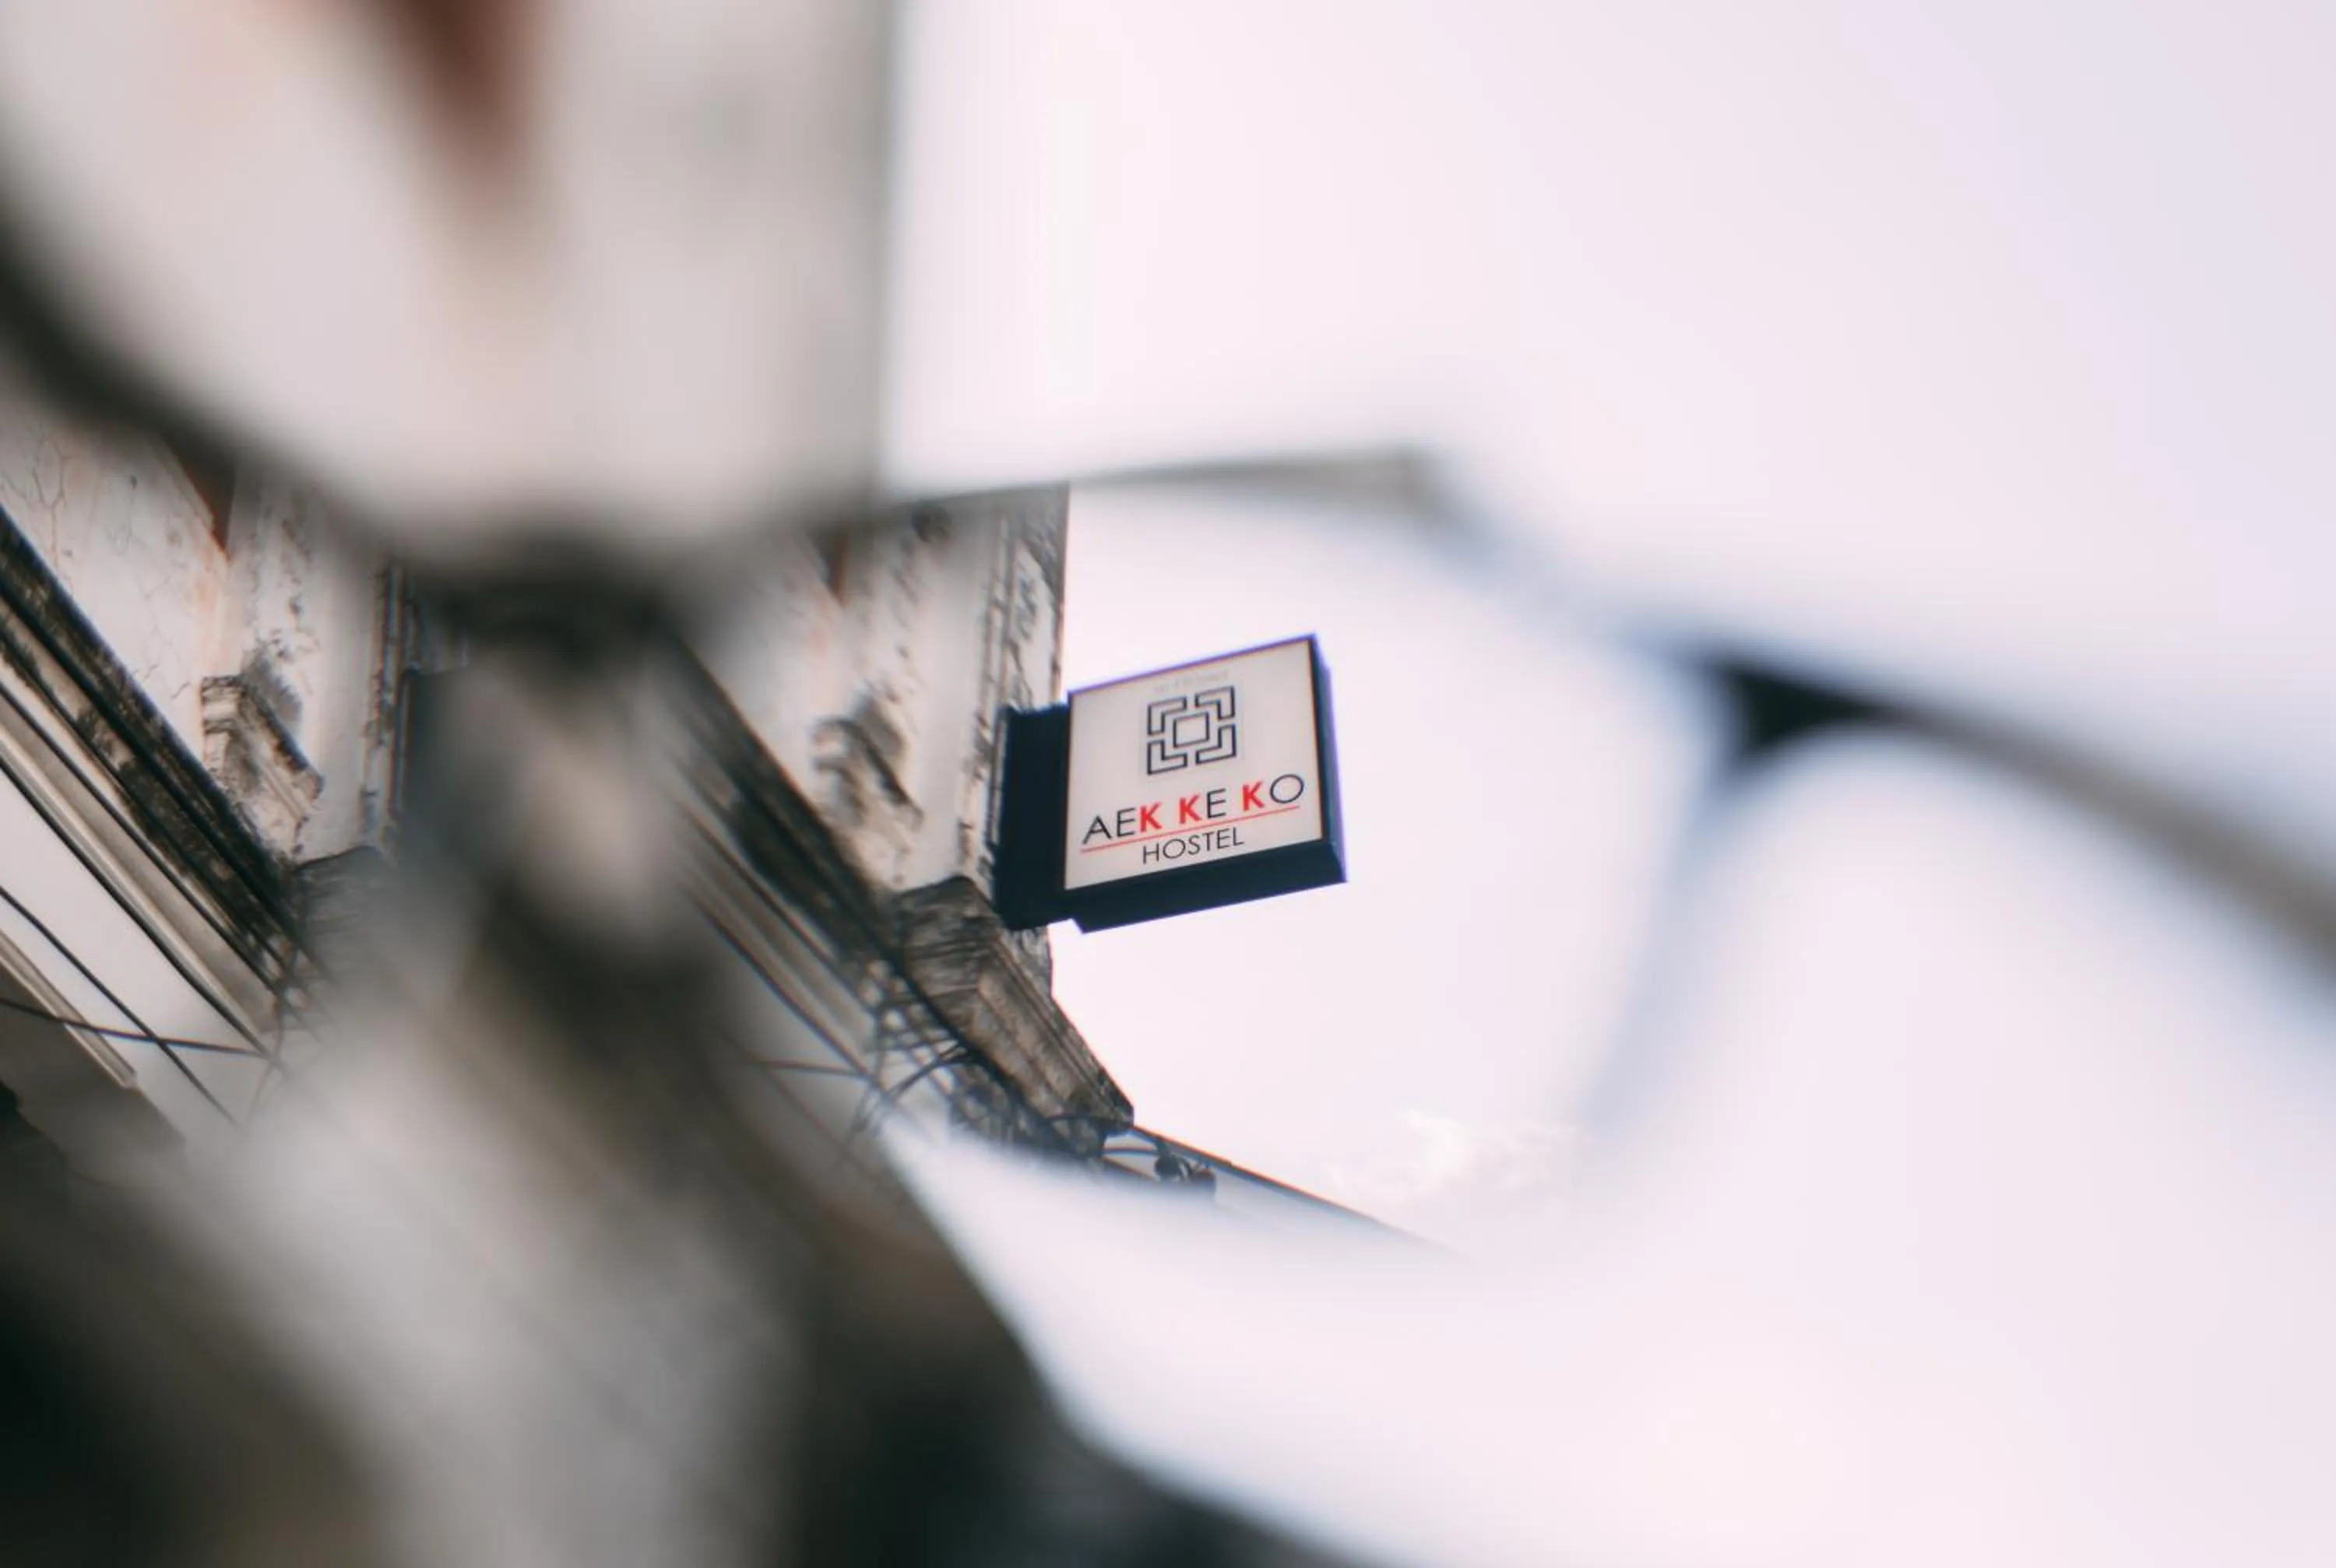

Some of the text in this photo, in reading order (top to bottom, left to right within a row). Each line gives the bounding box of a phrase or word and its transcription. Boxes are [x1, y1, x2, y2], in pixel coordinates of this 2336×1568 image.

[1082, 774, 1304, 845] AEK KE KO
[1142, 827, 1244, 864] HOSTEL
